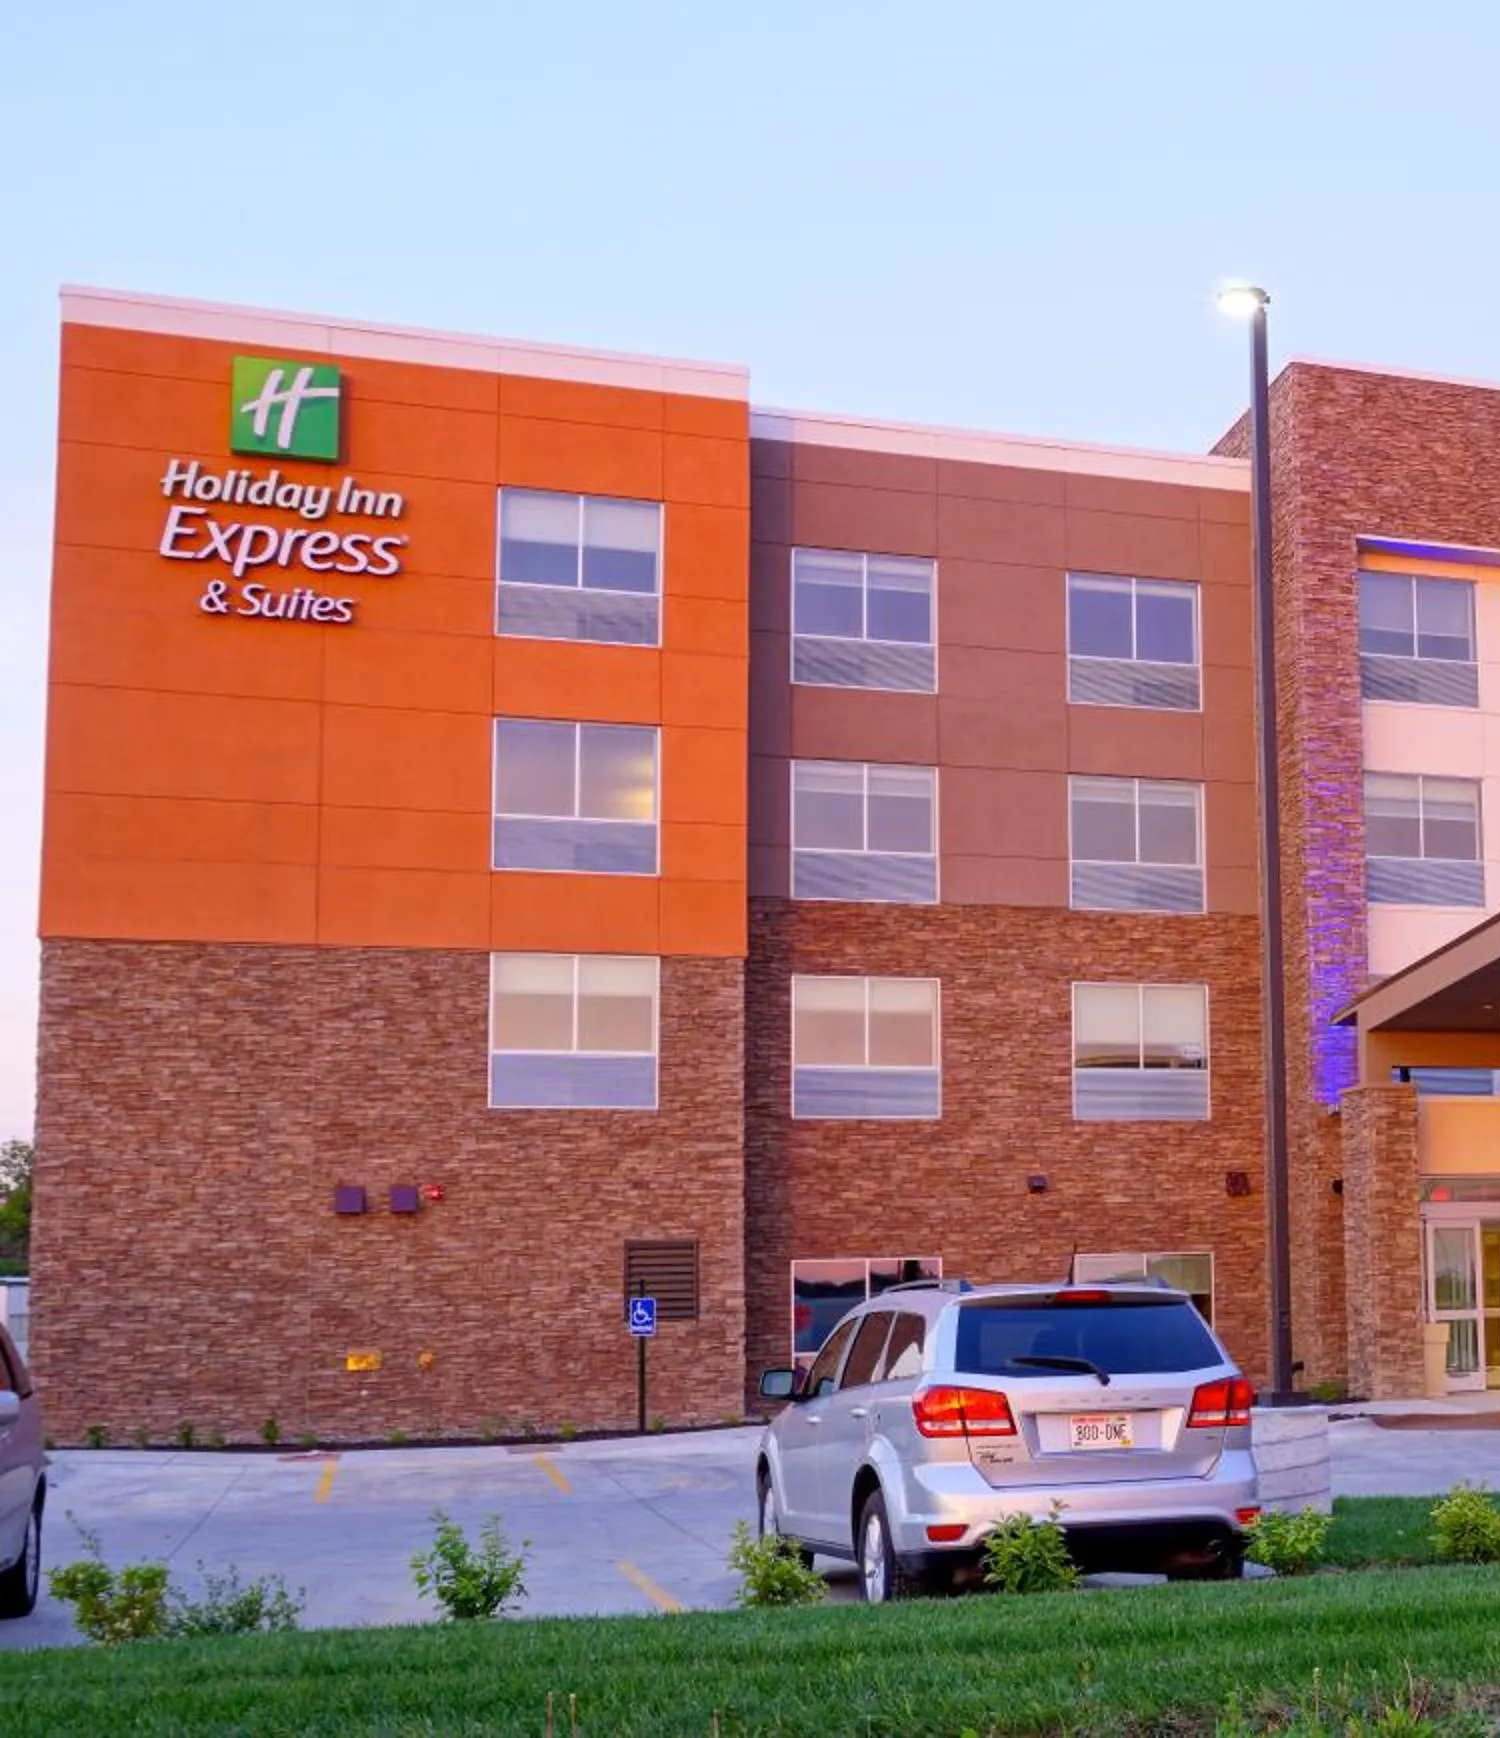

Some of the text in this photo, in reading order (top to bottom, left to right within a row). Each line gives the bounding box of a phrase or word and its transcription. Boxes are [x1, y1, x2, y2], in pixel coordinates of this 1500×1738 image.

[160, 459, 402, 519] Holiday Inn
[159, 504, 403, 577] Express
[199, 579, 354, 622] & Suites
